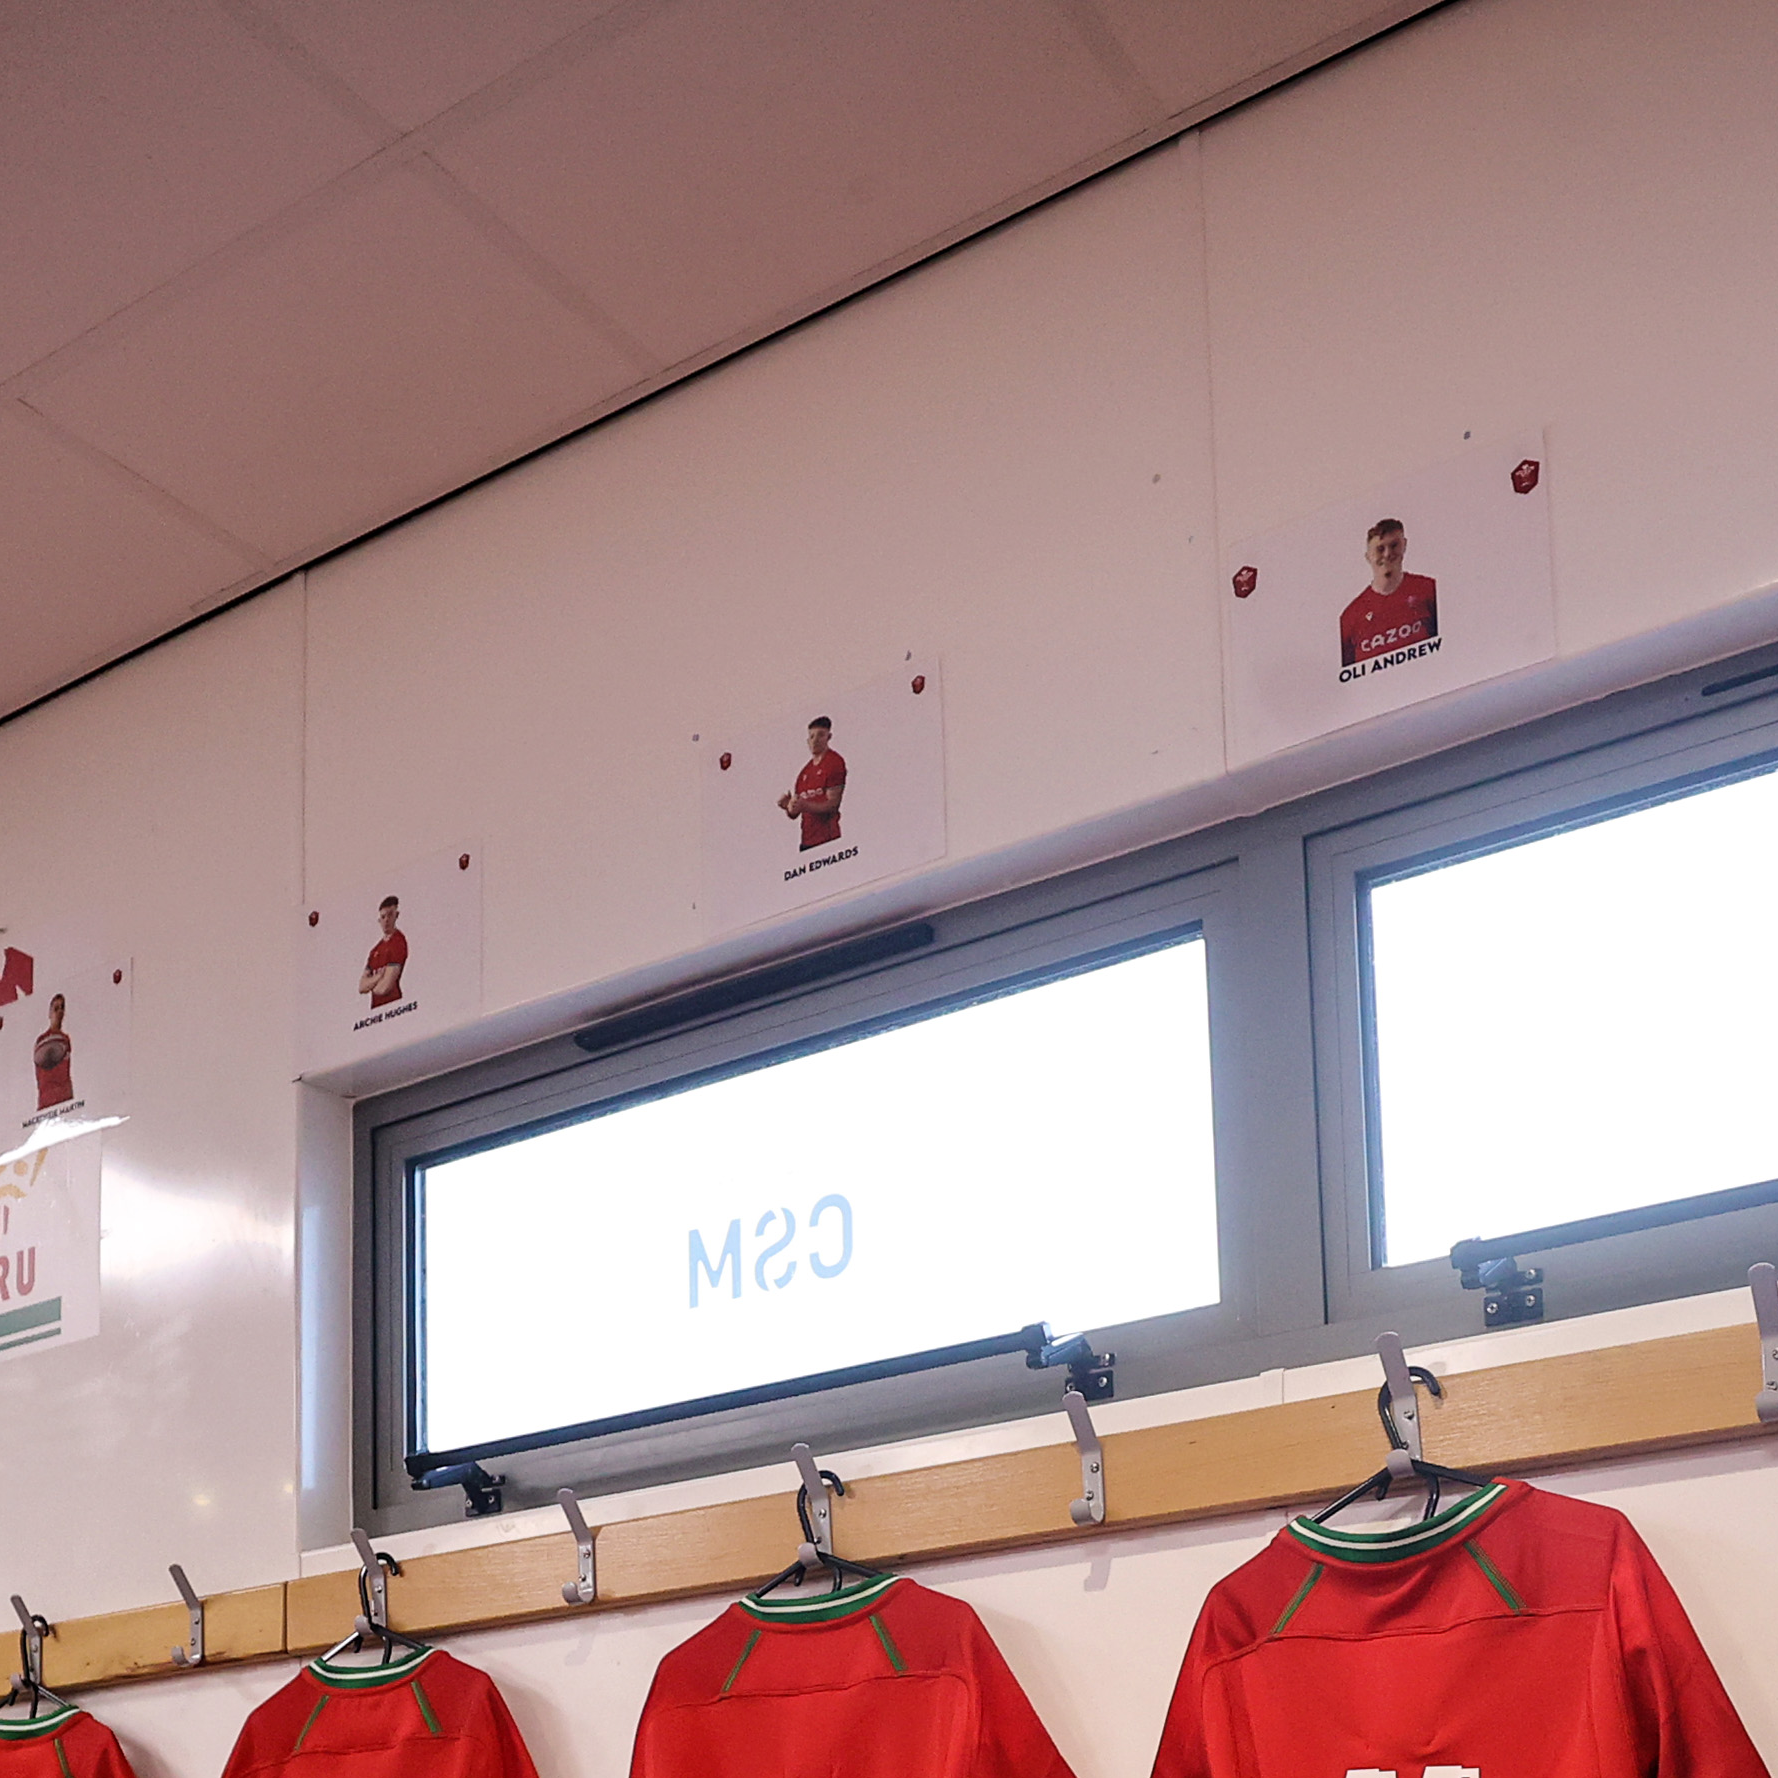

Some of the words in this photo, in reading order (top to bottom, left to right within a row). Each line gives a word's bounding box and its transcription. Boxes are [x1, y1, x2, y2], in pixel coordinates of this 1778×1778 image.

[1339, 663, 1366, 683] OLI
[1371, 637, 1442, 673] ANDREW
[784, 864, 807, 881] DAN
[809, 845, 859, 872] EDWARDS
[385, 1000, 418, 1020] HUGHES
